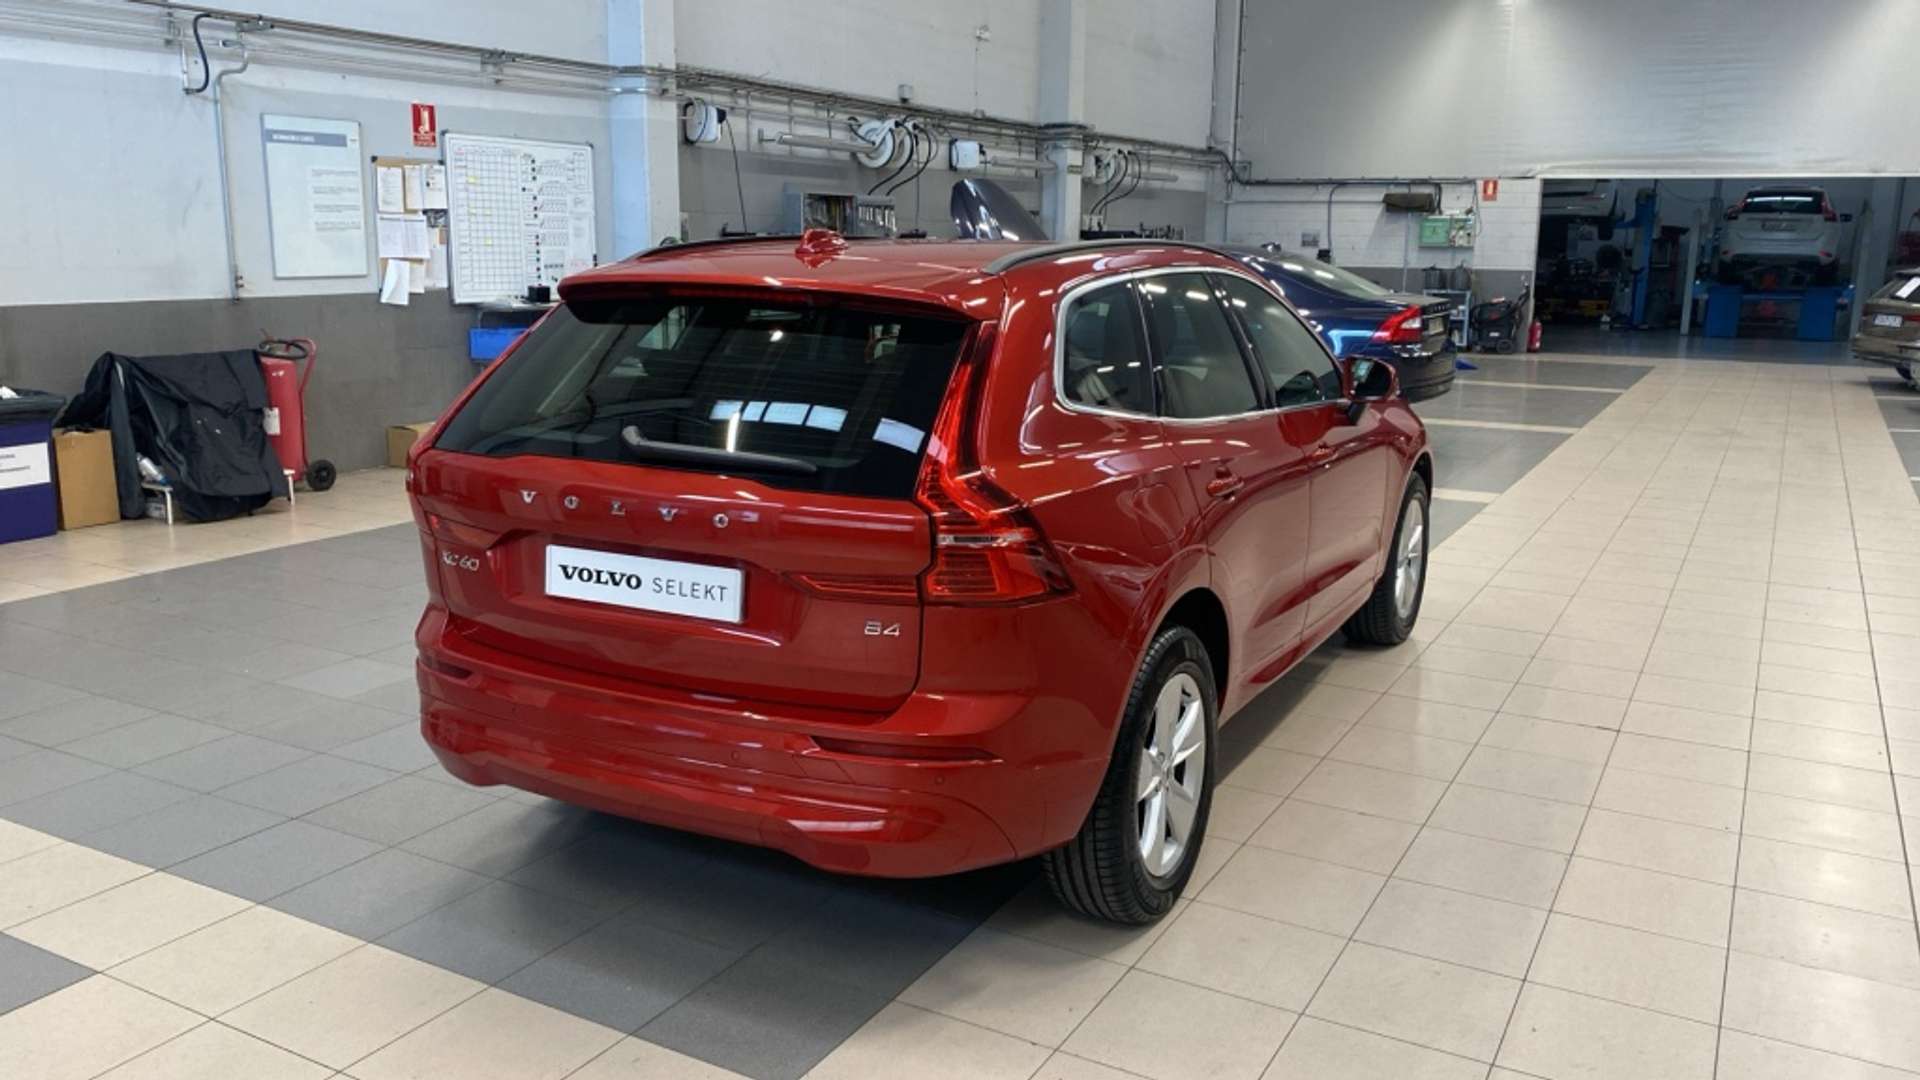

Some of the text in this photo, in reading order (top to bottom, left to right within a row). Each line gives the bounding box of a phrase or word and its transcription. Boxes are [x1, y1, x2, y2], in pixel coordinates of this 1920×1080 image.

[520, 489, 730, 529] VOLVO
[558, 564, 728, 602] VOLVO SELEKT
[864, 621, 901, 636] B4
